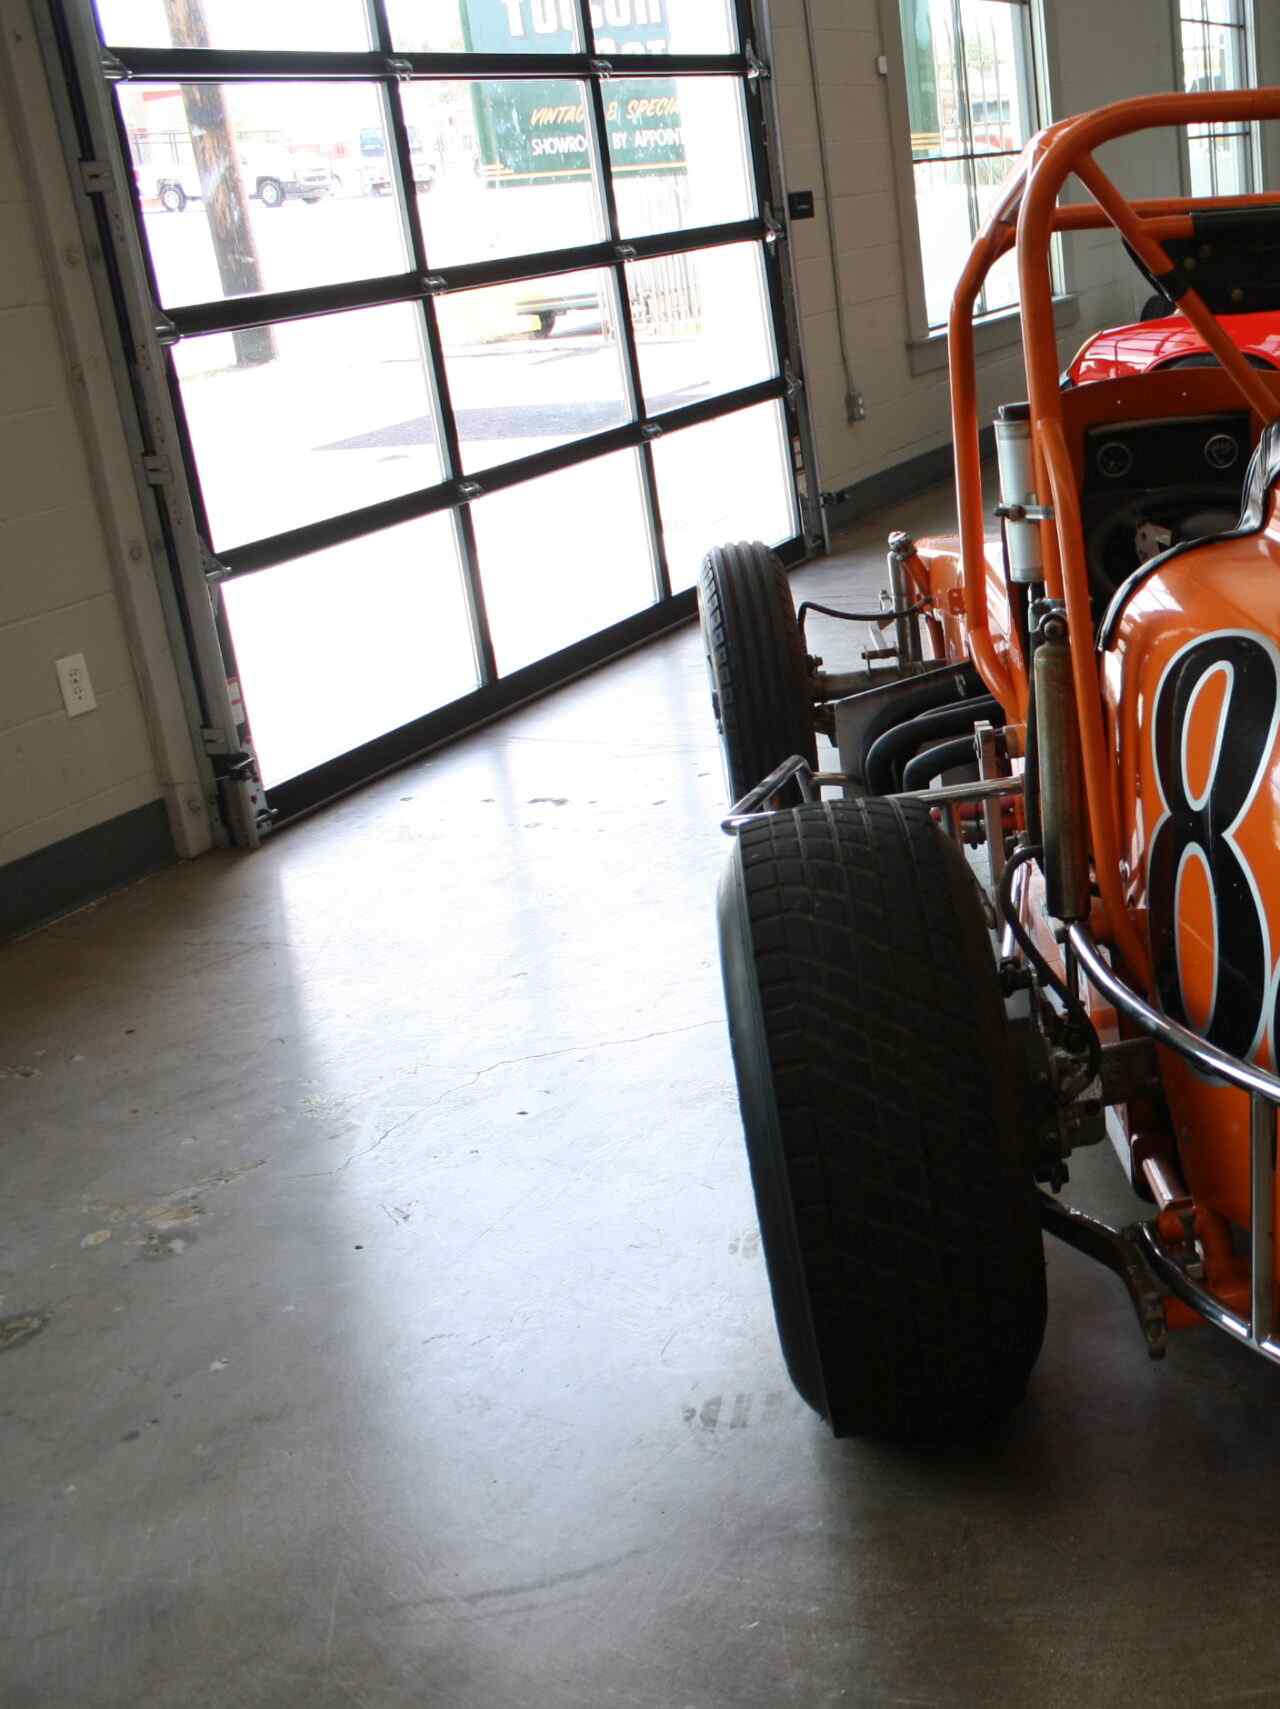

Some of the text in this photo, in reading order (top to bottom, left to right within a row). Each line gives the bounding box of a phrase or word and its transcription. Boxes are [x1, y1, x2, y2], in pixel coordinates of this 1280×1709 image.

[531, 103, 587, 127] VINTAG
[626, 96, 681, 119] SPECIA
[531, 134, 588, 156] SHOWRO
[612, 132, 627, 150] BY
